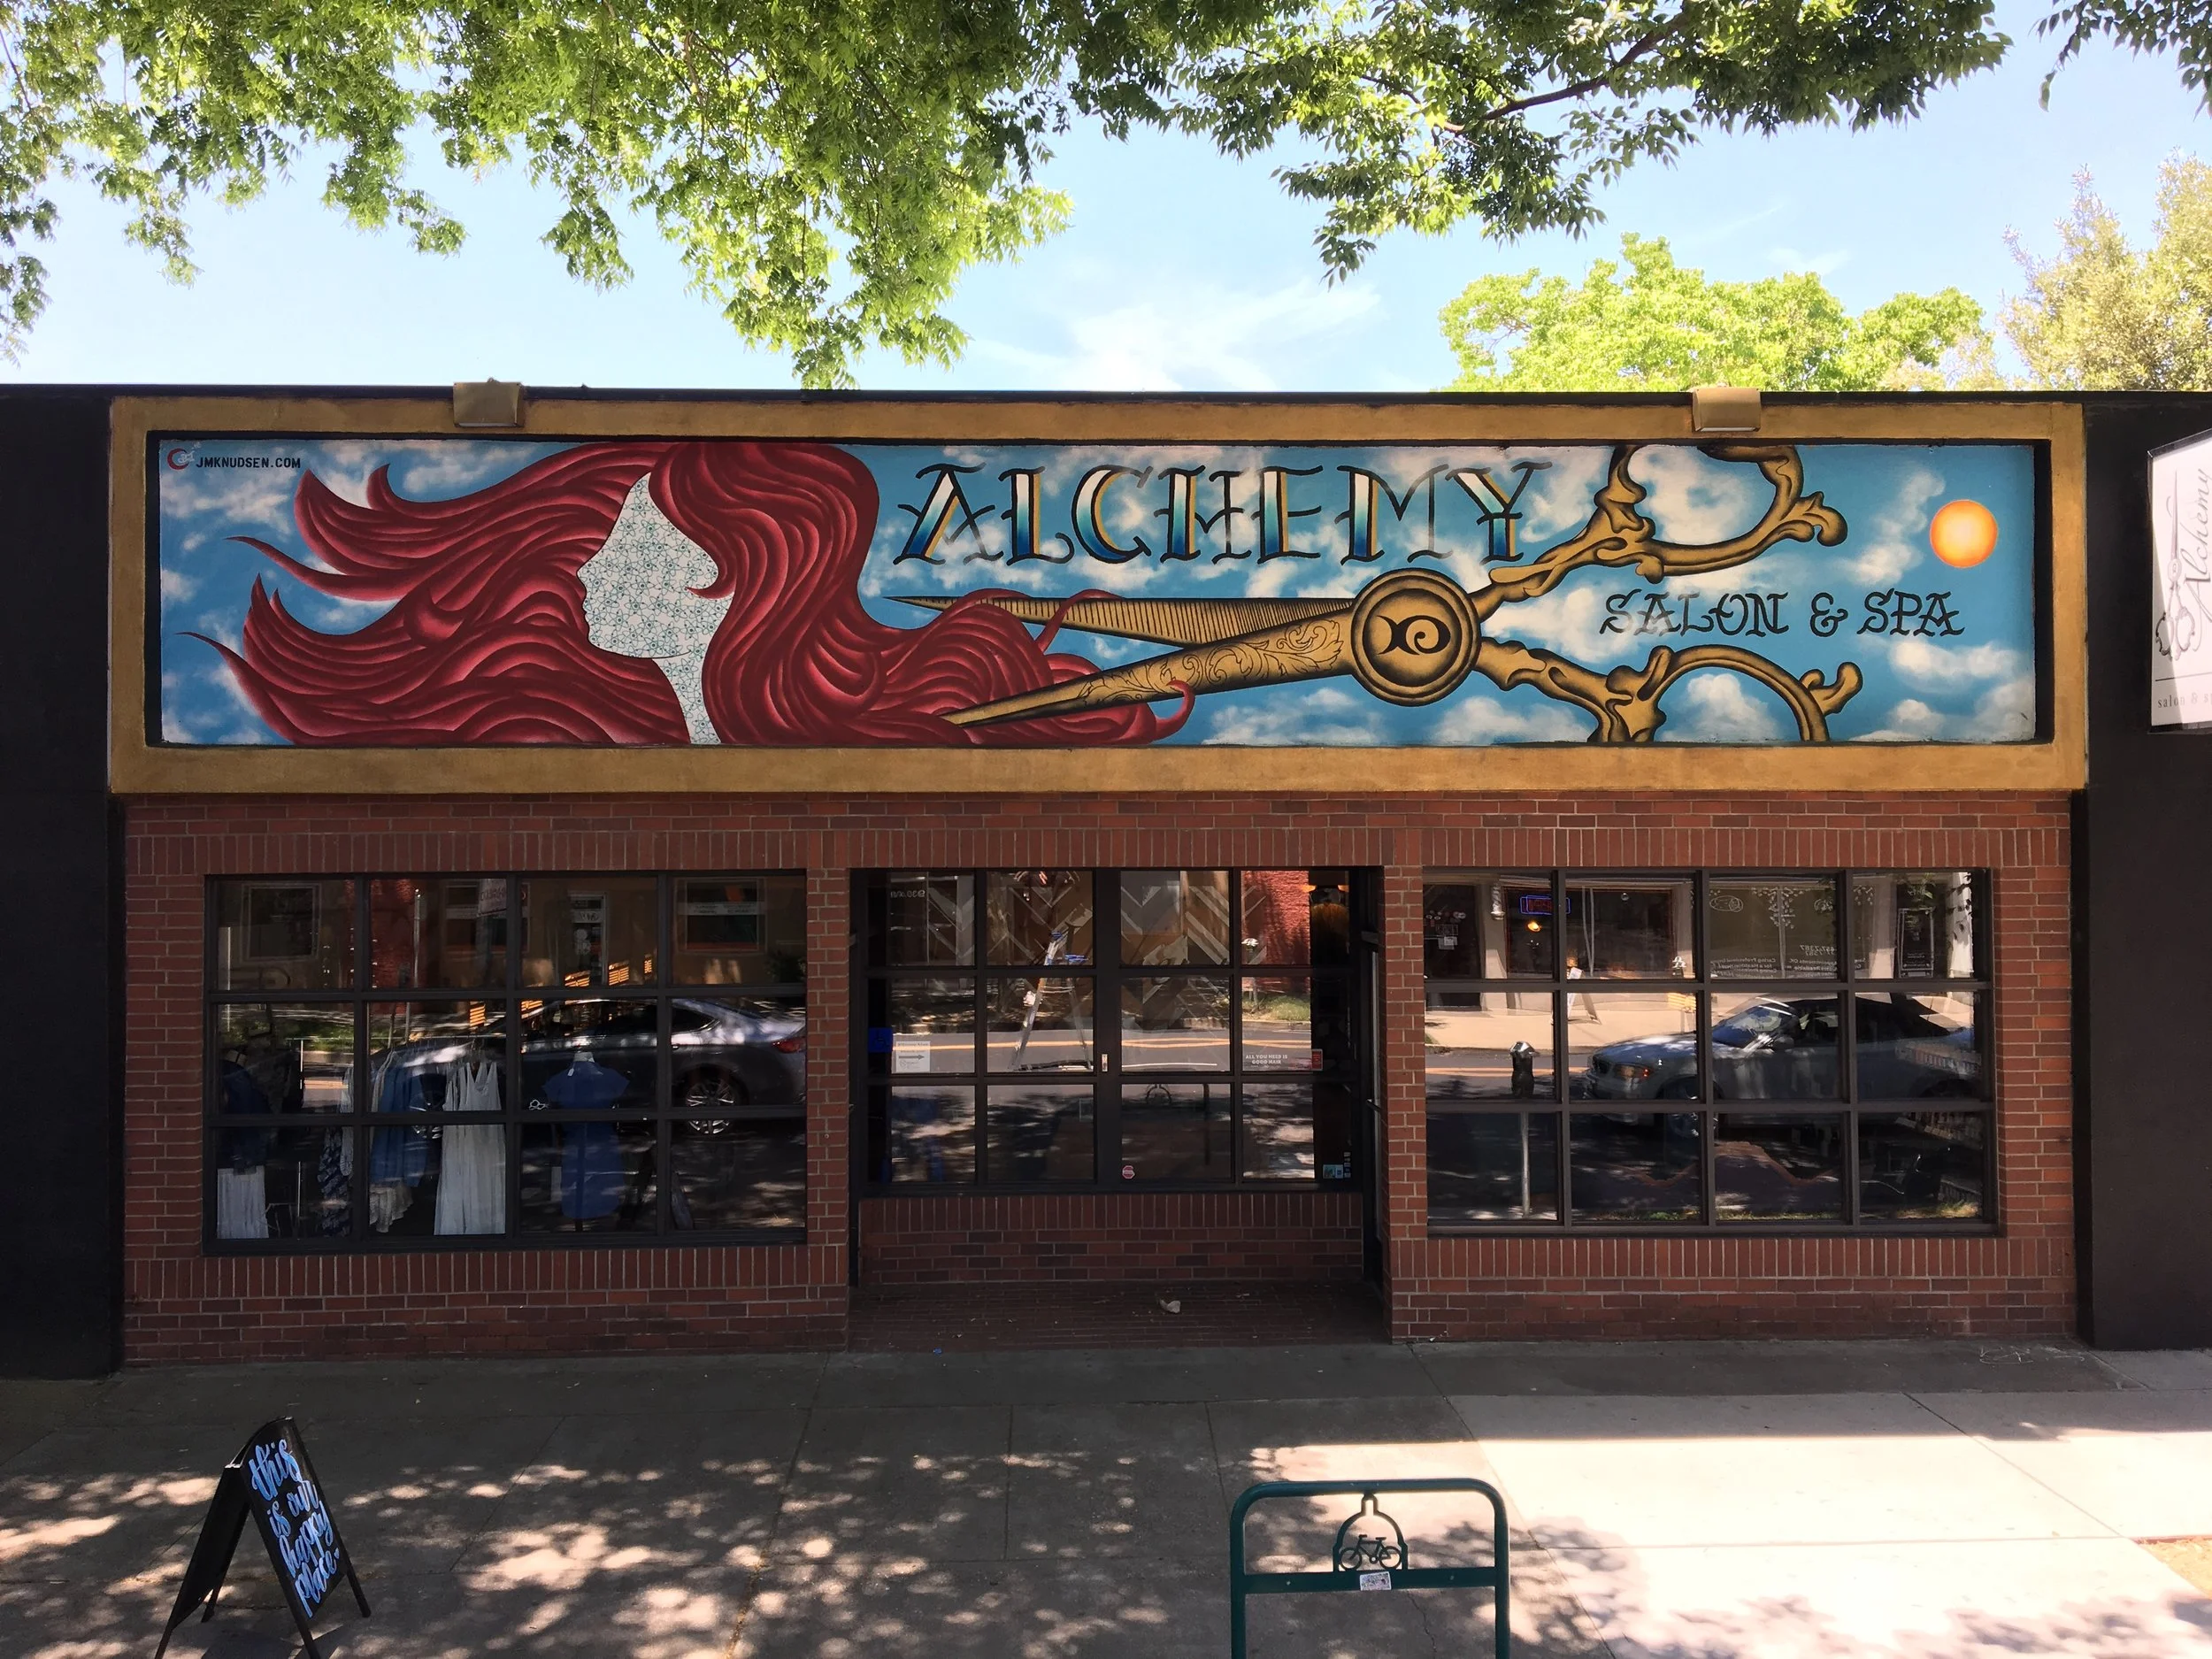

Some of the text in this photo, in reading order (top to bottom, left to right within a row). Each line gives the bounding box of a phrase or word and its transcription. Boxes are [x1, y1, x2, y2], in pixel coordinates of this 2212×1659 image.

[196, 457, 301, 469] JMKNUDSEN.COM
[893, 463, 1553, 566] ALCHEMY
[2178, 468, 2212, 652] Alchemy
[1600, 588, 1965, 637] SALON & SPA
[2157, 694, 2185, 709] salon
[249, 1439, 302, 1502] this
[266, 1479, 319, 1538] is our
[279, 1500, 334, 1578] happy
